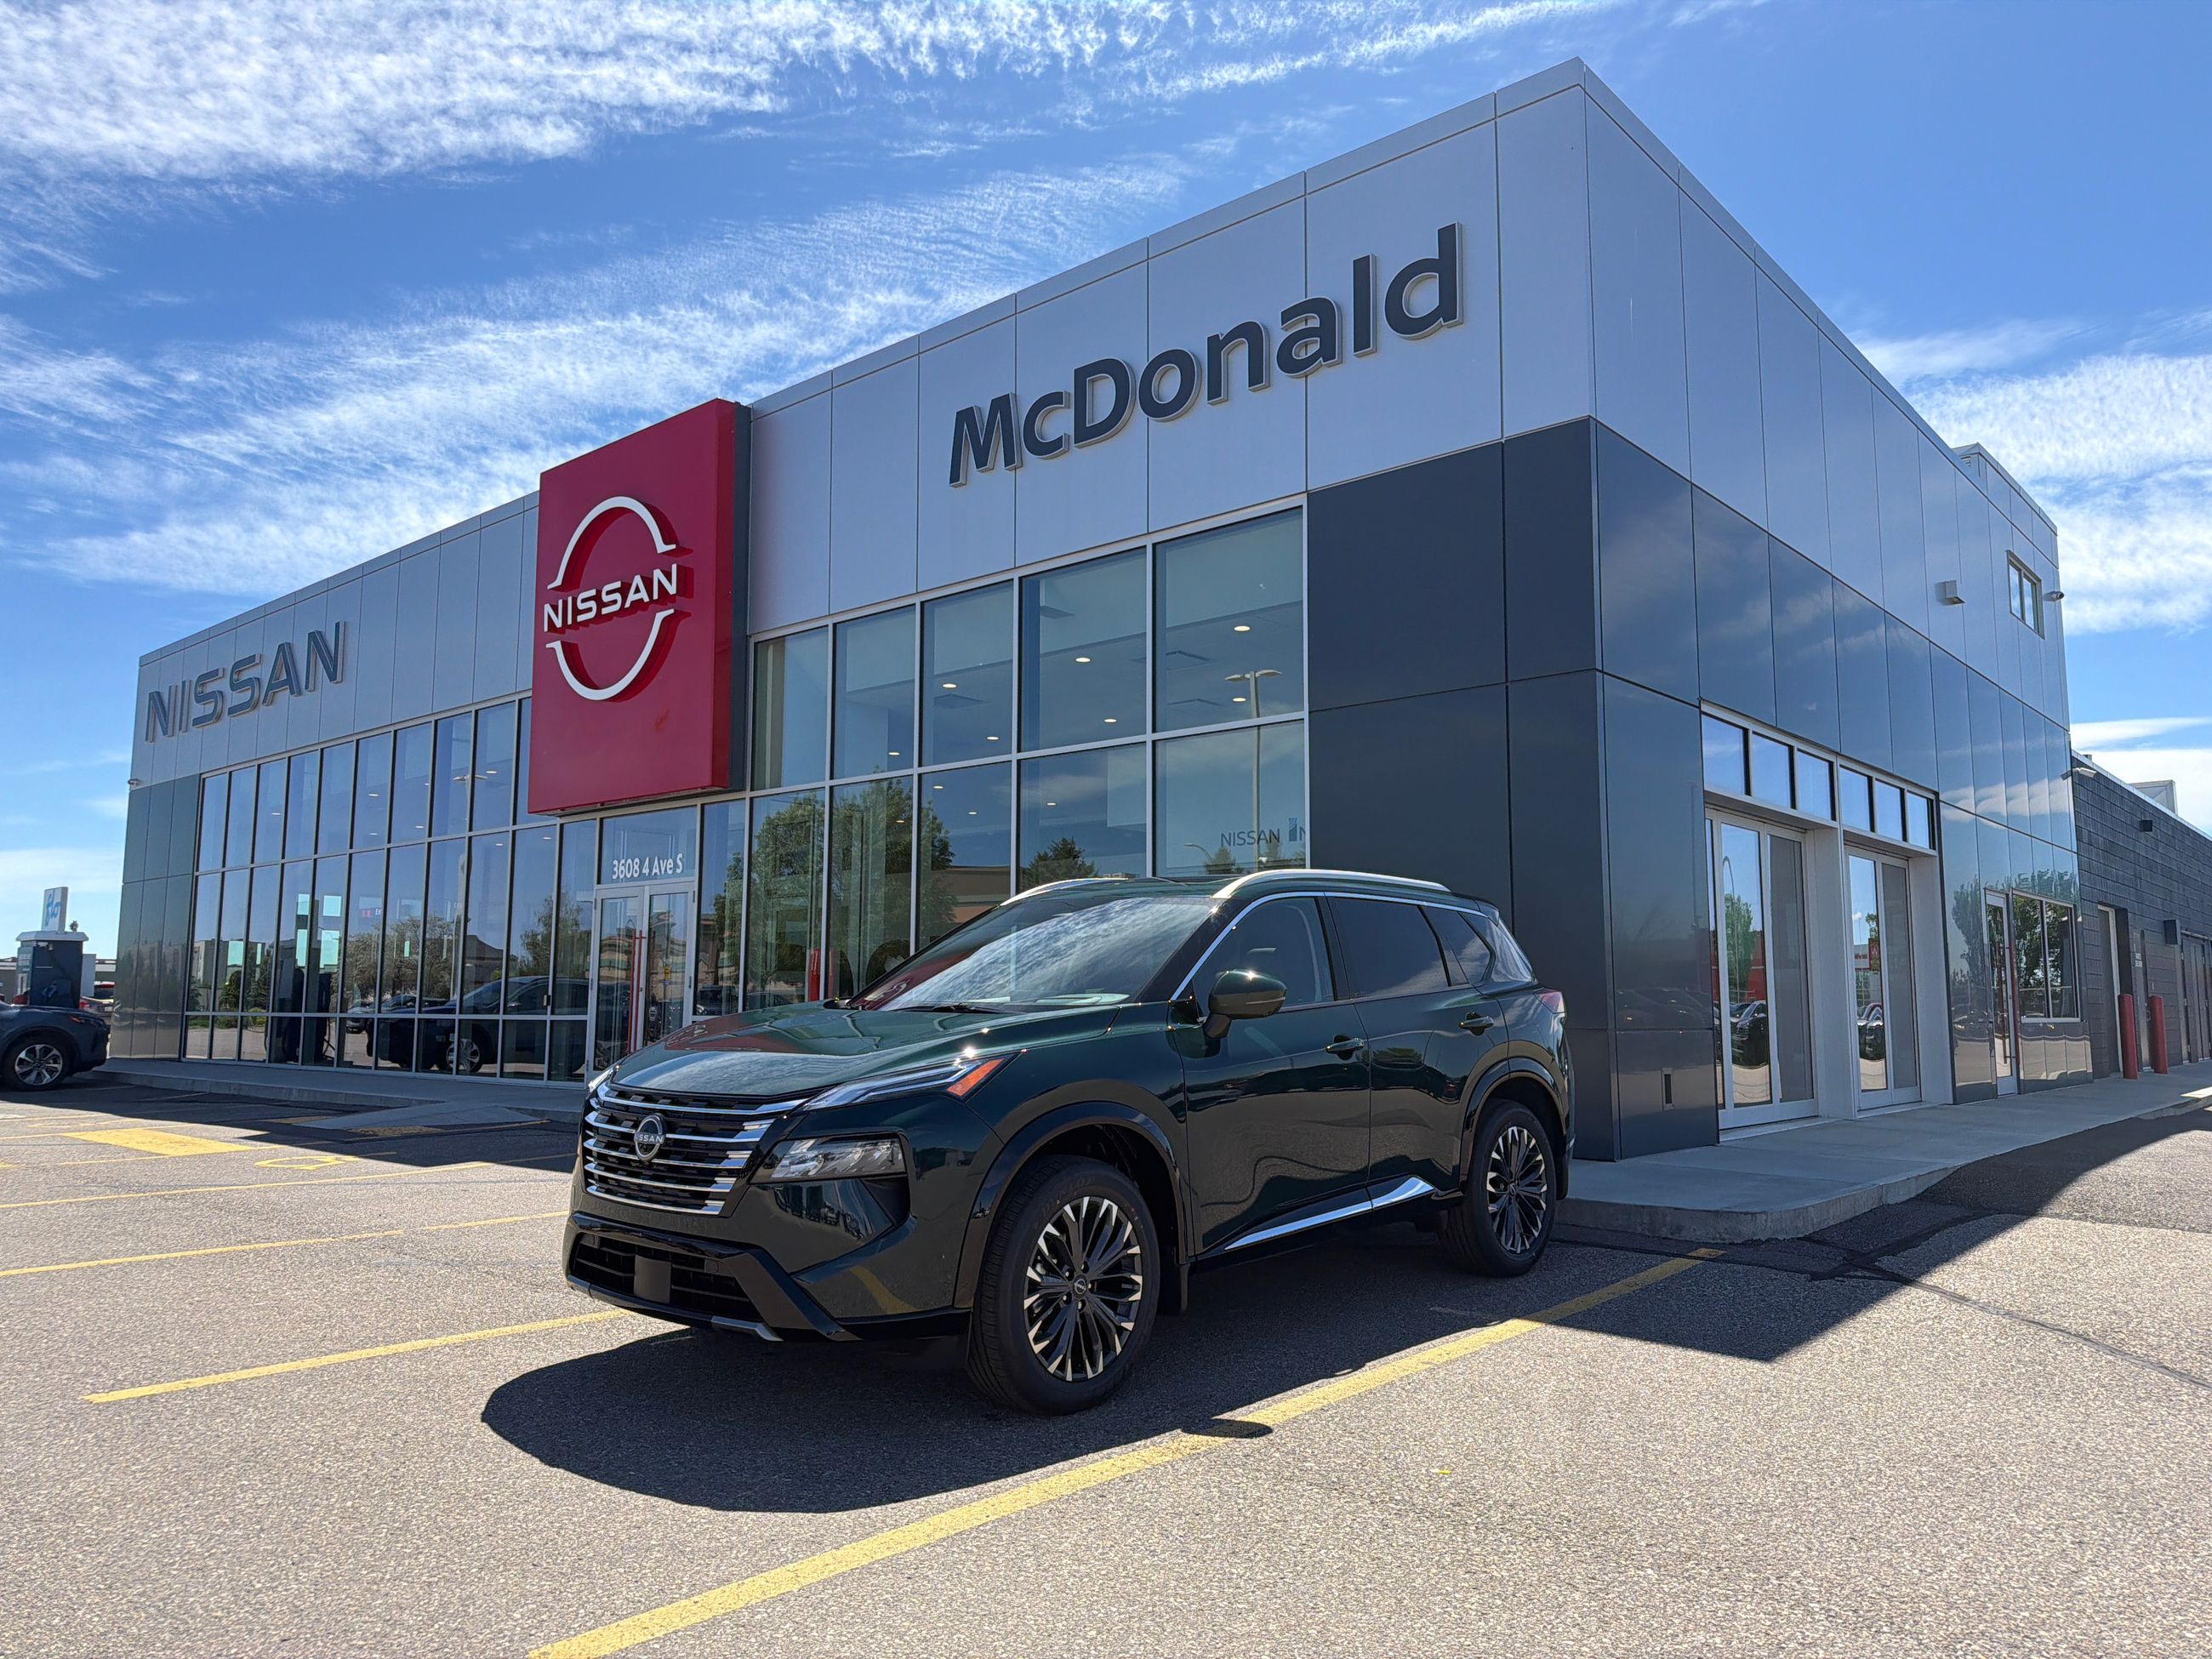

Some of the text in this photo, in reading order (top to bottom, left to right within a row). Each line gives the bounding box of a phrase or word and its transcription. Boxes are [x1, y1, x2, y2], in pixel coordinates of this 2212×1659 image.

[949, 221, 1463, 488] McDonald
[544, 563, 677, 633] NISSAN
[145, 620, 346, 743] NISSAN
[613, 853, 683, 879] 3608 4 Ave S
[1221, 828, 1280, 847] NISSAN
